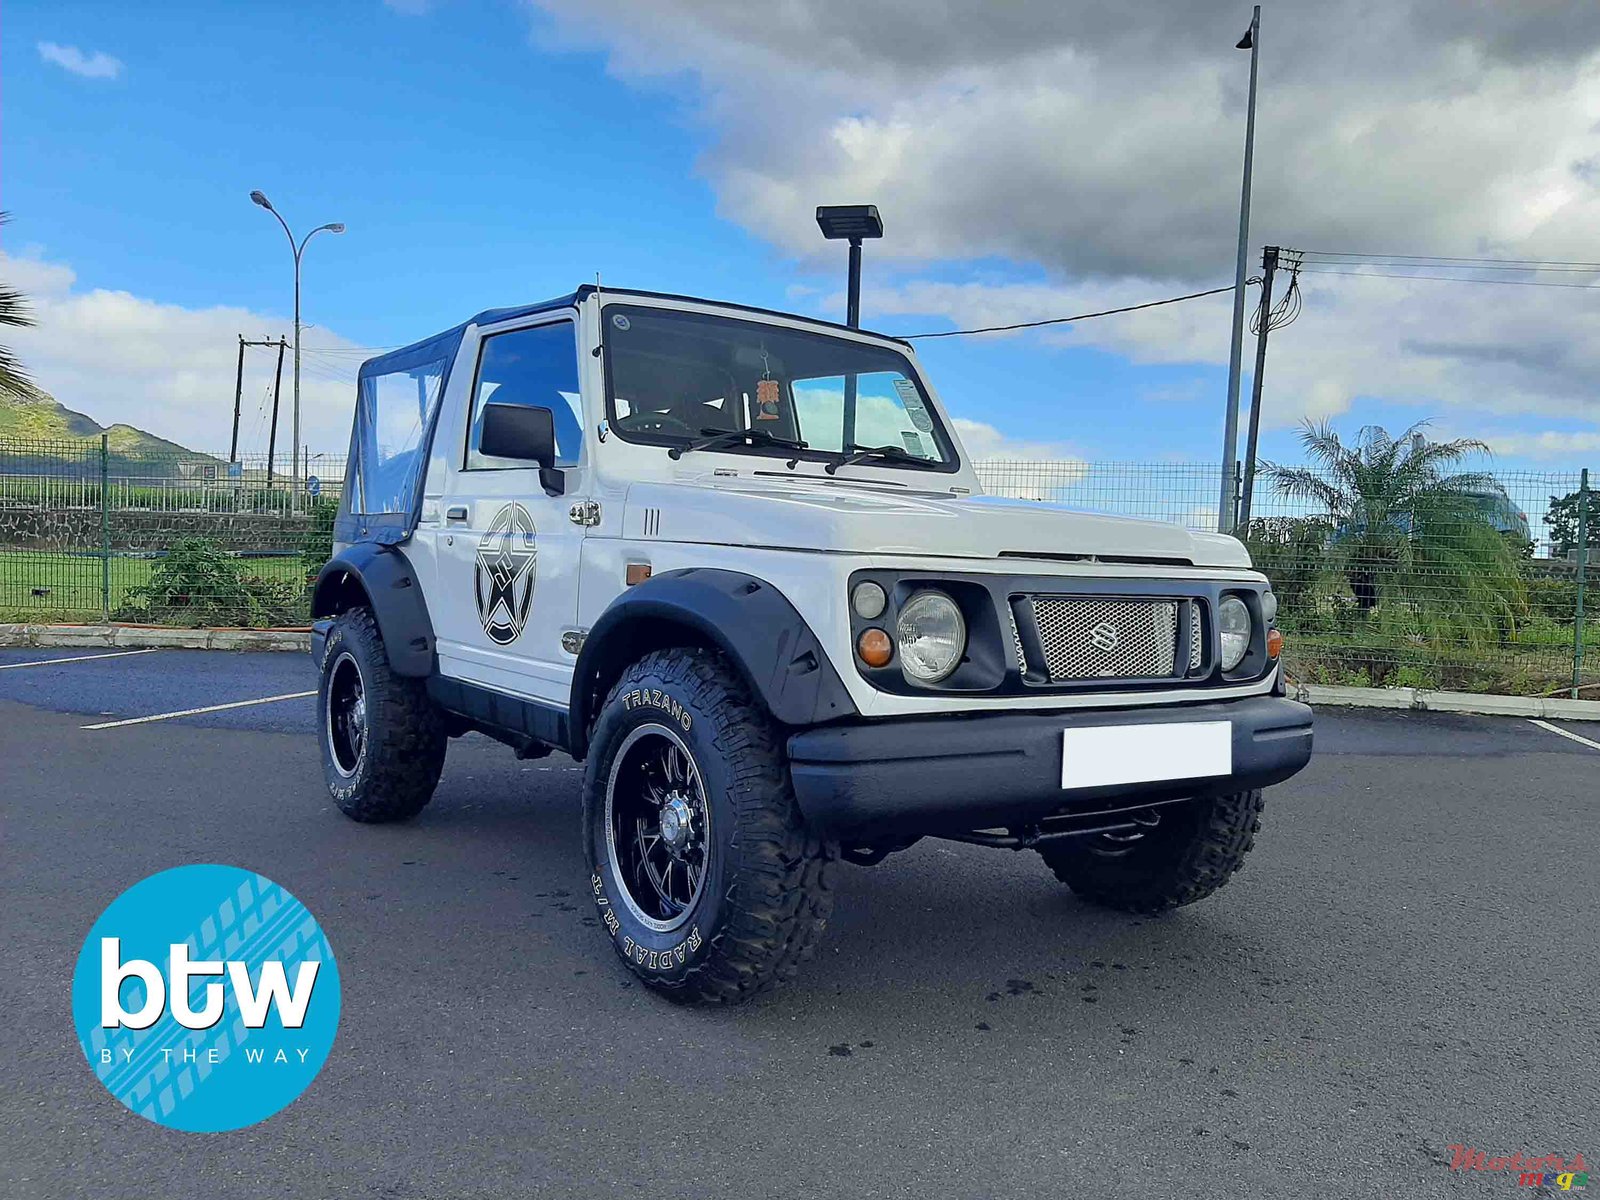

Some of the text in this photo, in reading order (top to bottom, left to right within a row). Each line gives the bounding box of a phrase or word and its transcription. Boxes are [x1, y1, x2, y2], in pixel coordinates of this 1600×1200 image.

[621, 688, 692, 731] TRAZANO
[591, 873, 619, 936] M/T
[623, 926, 702, 970] RADIAL
